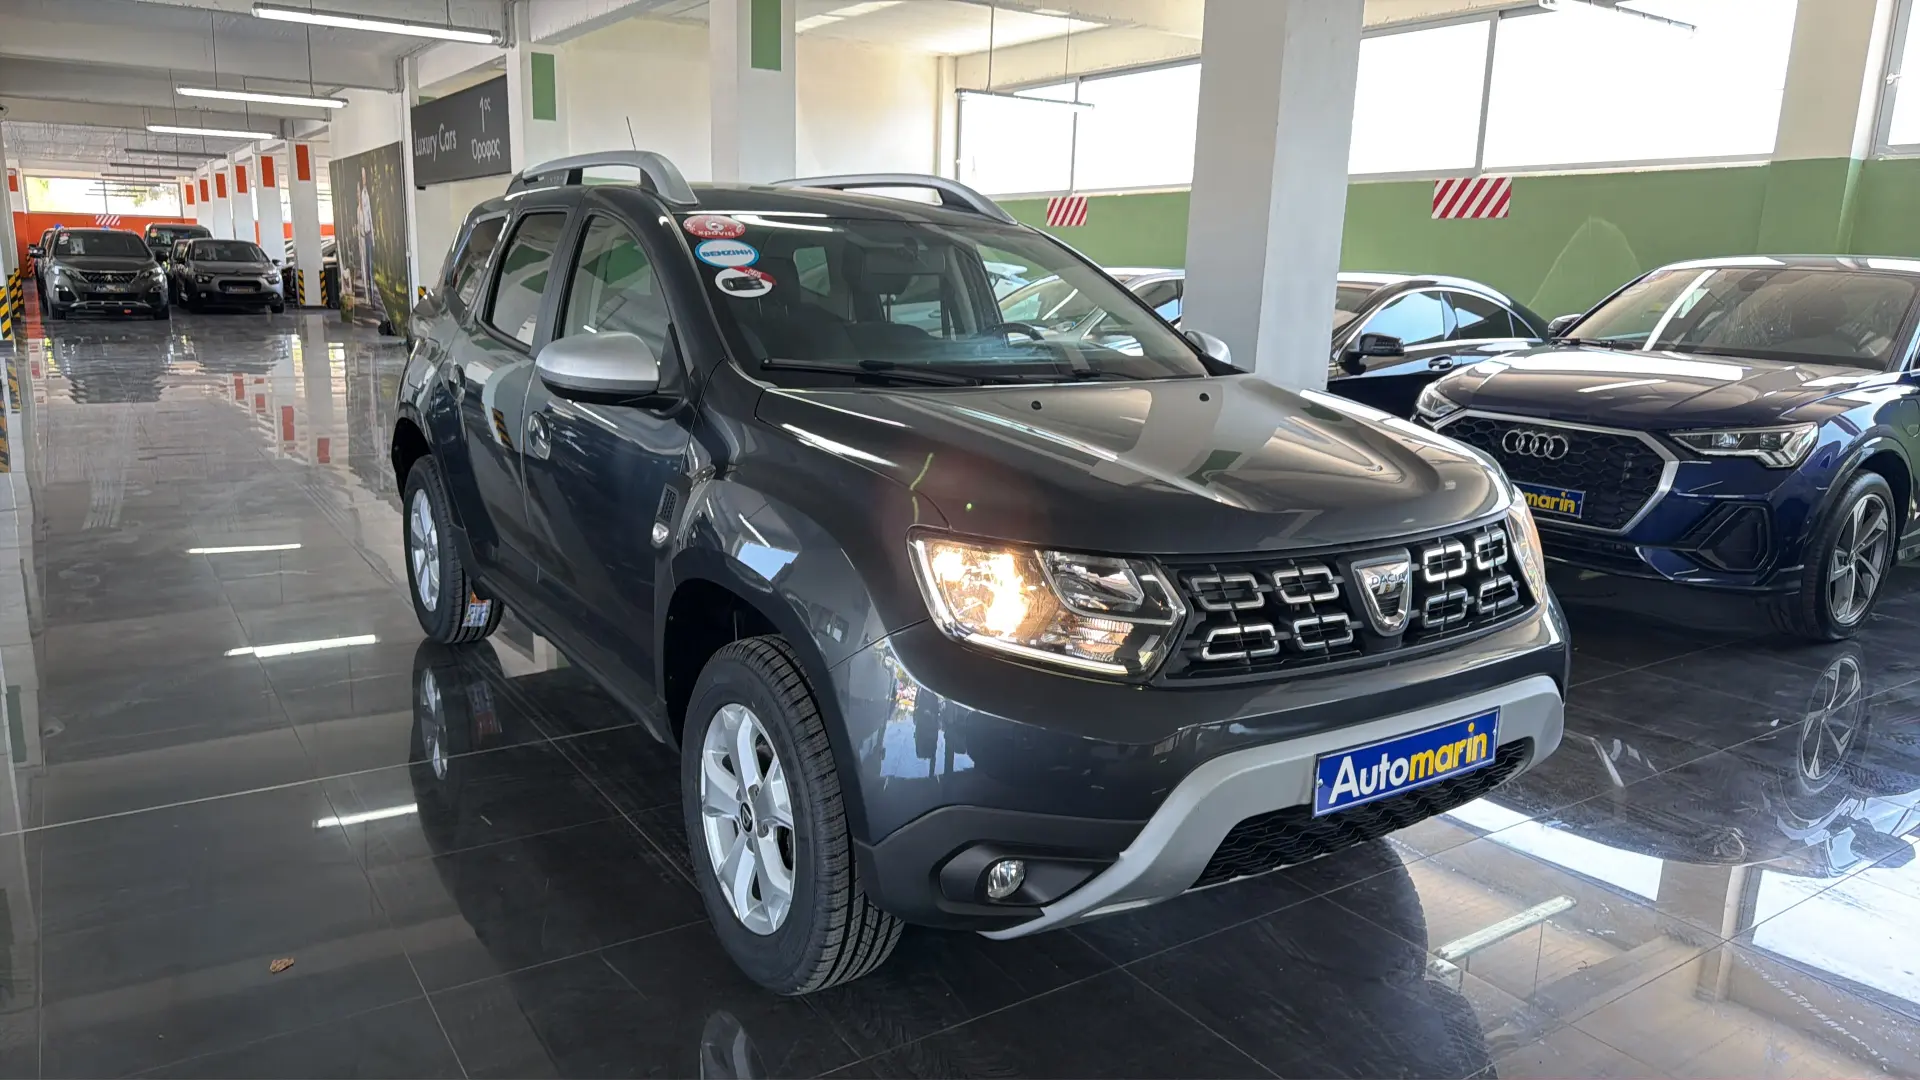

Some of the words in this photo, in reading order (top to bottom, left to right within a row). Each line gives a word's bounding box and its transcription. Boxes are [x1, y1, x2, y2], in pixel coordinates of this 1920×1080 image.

[414, 129, 438, 163] Luxury
[438, 122, 457, 152] Cars
[1523, 491, 1576, 514] marin
[1371, 573, 1406, 585] DACIA
[1328, 722, 1487, 805] Automarin
